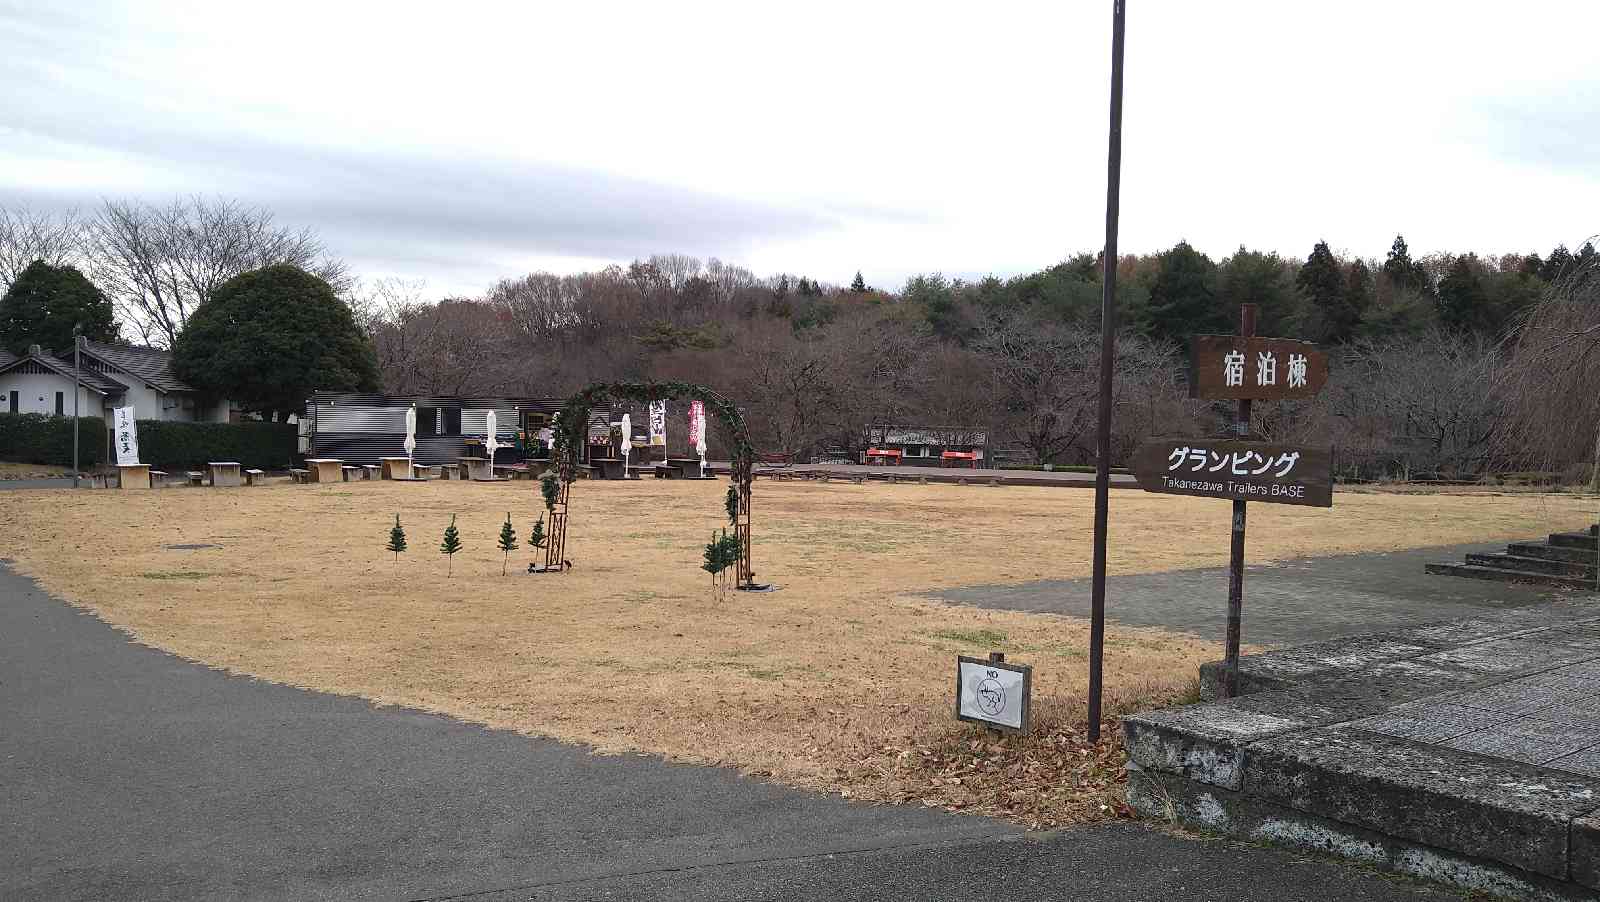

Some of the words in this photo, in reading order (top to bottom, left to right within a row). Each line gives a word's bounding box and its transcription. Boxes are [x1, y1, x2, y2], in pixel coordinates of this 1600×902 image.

[1223, 350, 1308, 389] 宿泊棟
[1168, 446, 1300, 478] グランピング
[1161, 475, 1223, 492] Takanezawa
[1227, 481, 1268, 496] Trailers
[1271, 484, 1305, 498] BASE
[986, 670, 999, 679] NO
